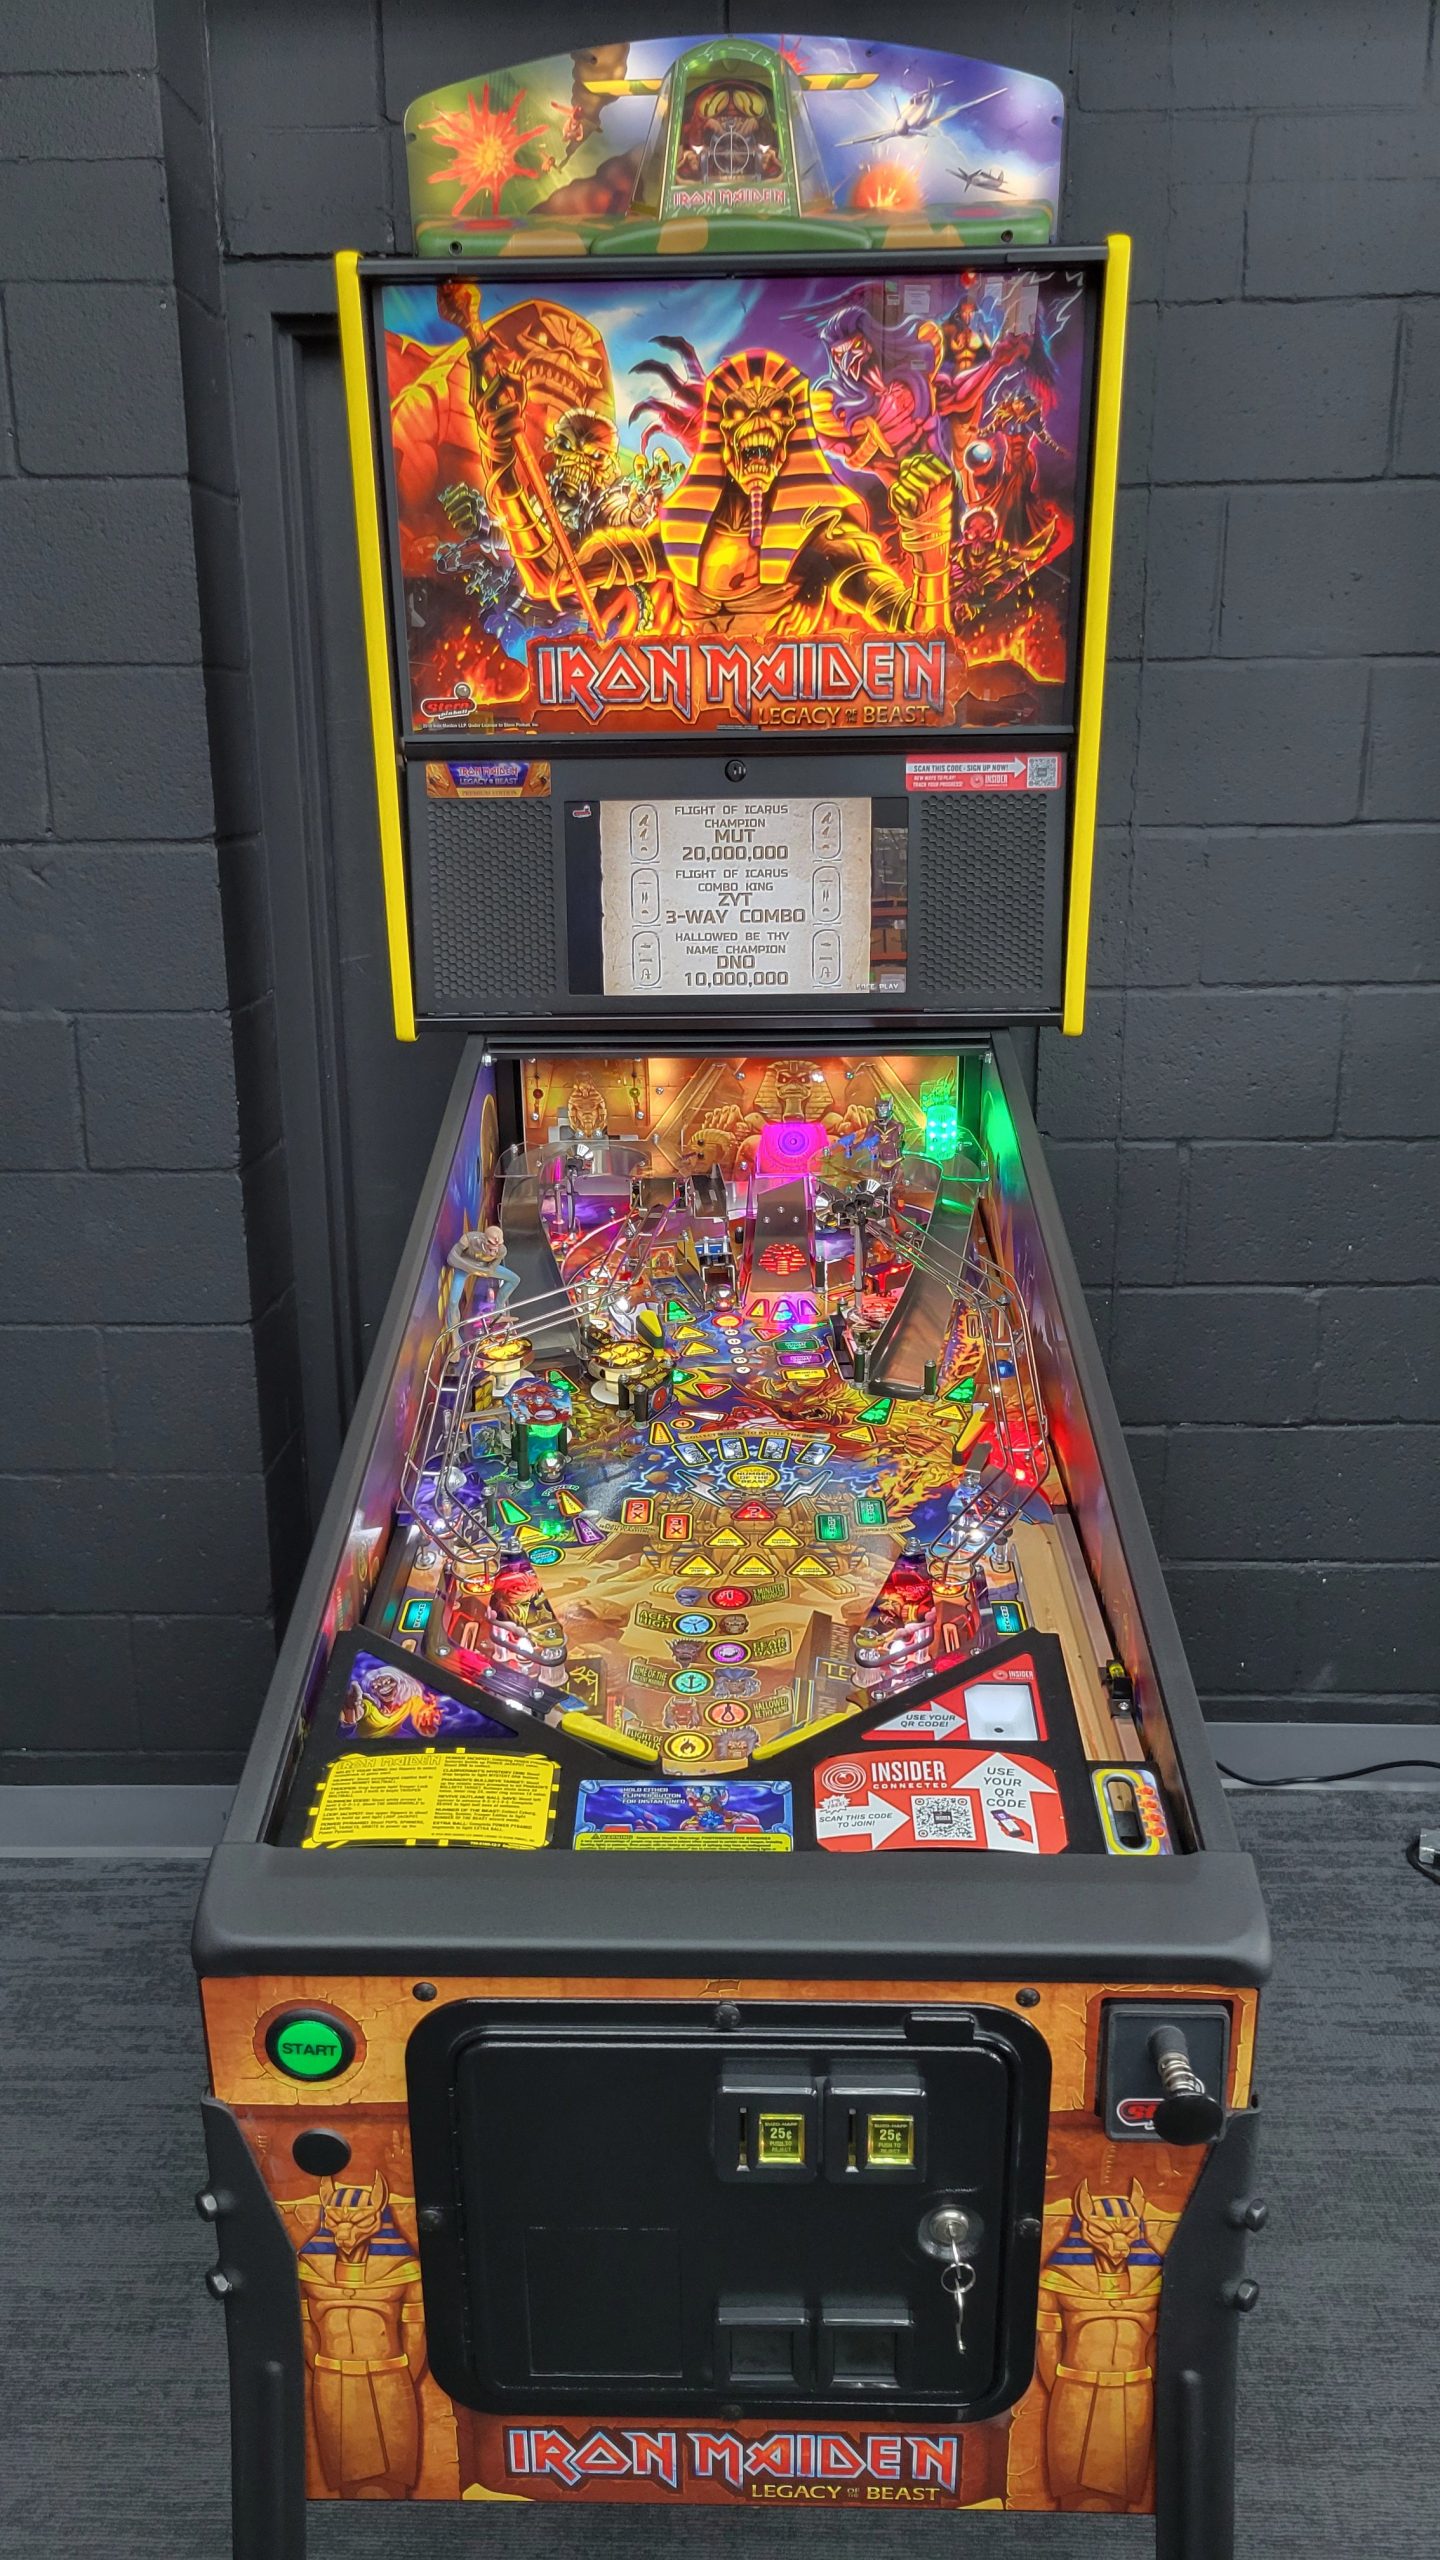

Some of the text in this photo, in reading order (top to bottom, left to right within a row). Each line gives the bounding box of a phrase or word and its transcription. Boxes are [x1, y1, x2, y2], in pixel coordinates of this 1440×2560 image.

[673, 187, 786, 208] IRON MAIDEN
[538, 641, 946, 721] IRON MAIDEN
[426, 700, 472, 712] Stern
[758, 706, 841, 725] LEGACY
[863, 704, 931, 724] BEAST
[459, 766, 518, 777] IRON MAIDEN
[913, 765, 931, 773] SCAN
[966, 764, 981, 772] SIGN
[495, 777, 518, 785] BEAST
[985, 774, 1008, 784] INSIDER
[674, 804, 789, 815] FLIGHT OF ICARUS
[704, 818, 766, 828] CHAMPION
[714, 828, 756, 844] MUT
[682, 845, 789, 862] 20,000,000
[675, 868, 789, 879] FLIGHT OF ICARUS
[697, 882, 774, 892] COMBO KING
[718, 892, 753, 907] ZYT
[665, 908, 806, 924] 3-WAY COMBO
[675, 931, 790, 942] HALLOWED BE THY
[686, 944, 787, 955] NAME CHAMPION
[716, 955, 756, 969] DNO
[684, 971, 789, 988] 10,000,000
[639, 1609, 672, 1622] ACES
[640, 1616, 671, 1629] HIGH
[753, 1696, 788, 1711] HALLOWED
[900, 1720, 915, 1728] QR
[871, 1760, 947, 1782] INSIDER
[987, 1766, 1016, 1776] USE
[872, 1782, 948, 1790] CONNECTED
[984, 1776, 1022, 1787] YOUR
[994, 1788, 1015, 1798] QR
[986, 1798, 1028, 1809] CODE
[818, 1812, 893, 1823] SCAN THIS CODE
[851, 1820, 876, 1828] JOIN!
[281, 2042, 338, 2058] START
[770, 2127, 793, 2140] 25¢
[879, 2129, 902, 2142] 25¢
[508, 2428, 958, 2494] IRON MAIDEN
[751, 2484, 842, 2499] LEGACY
[866, 2486, 941, 2501] BEAST
